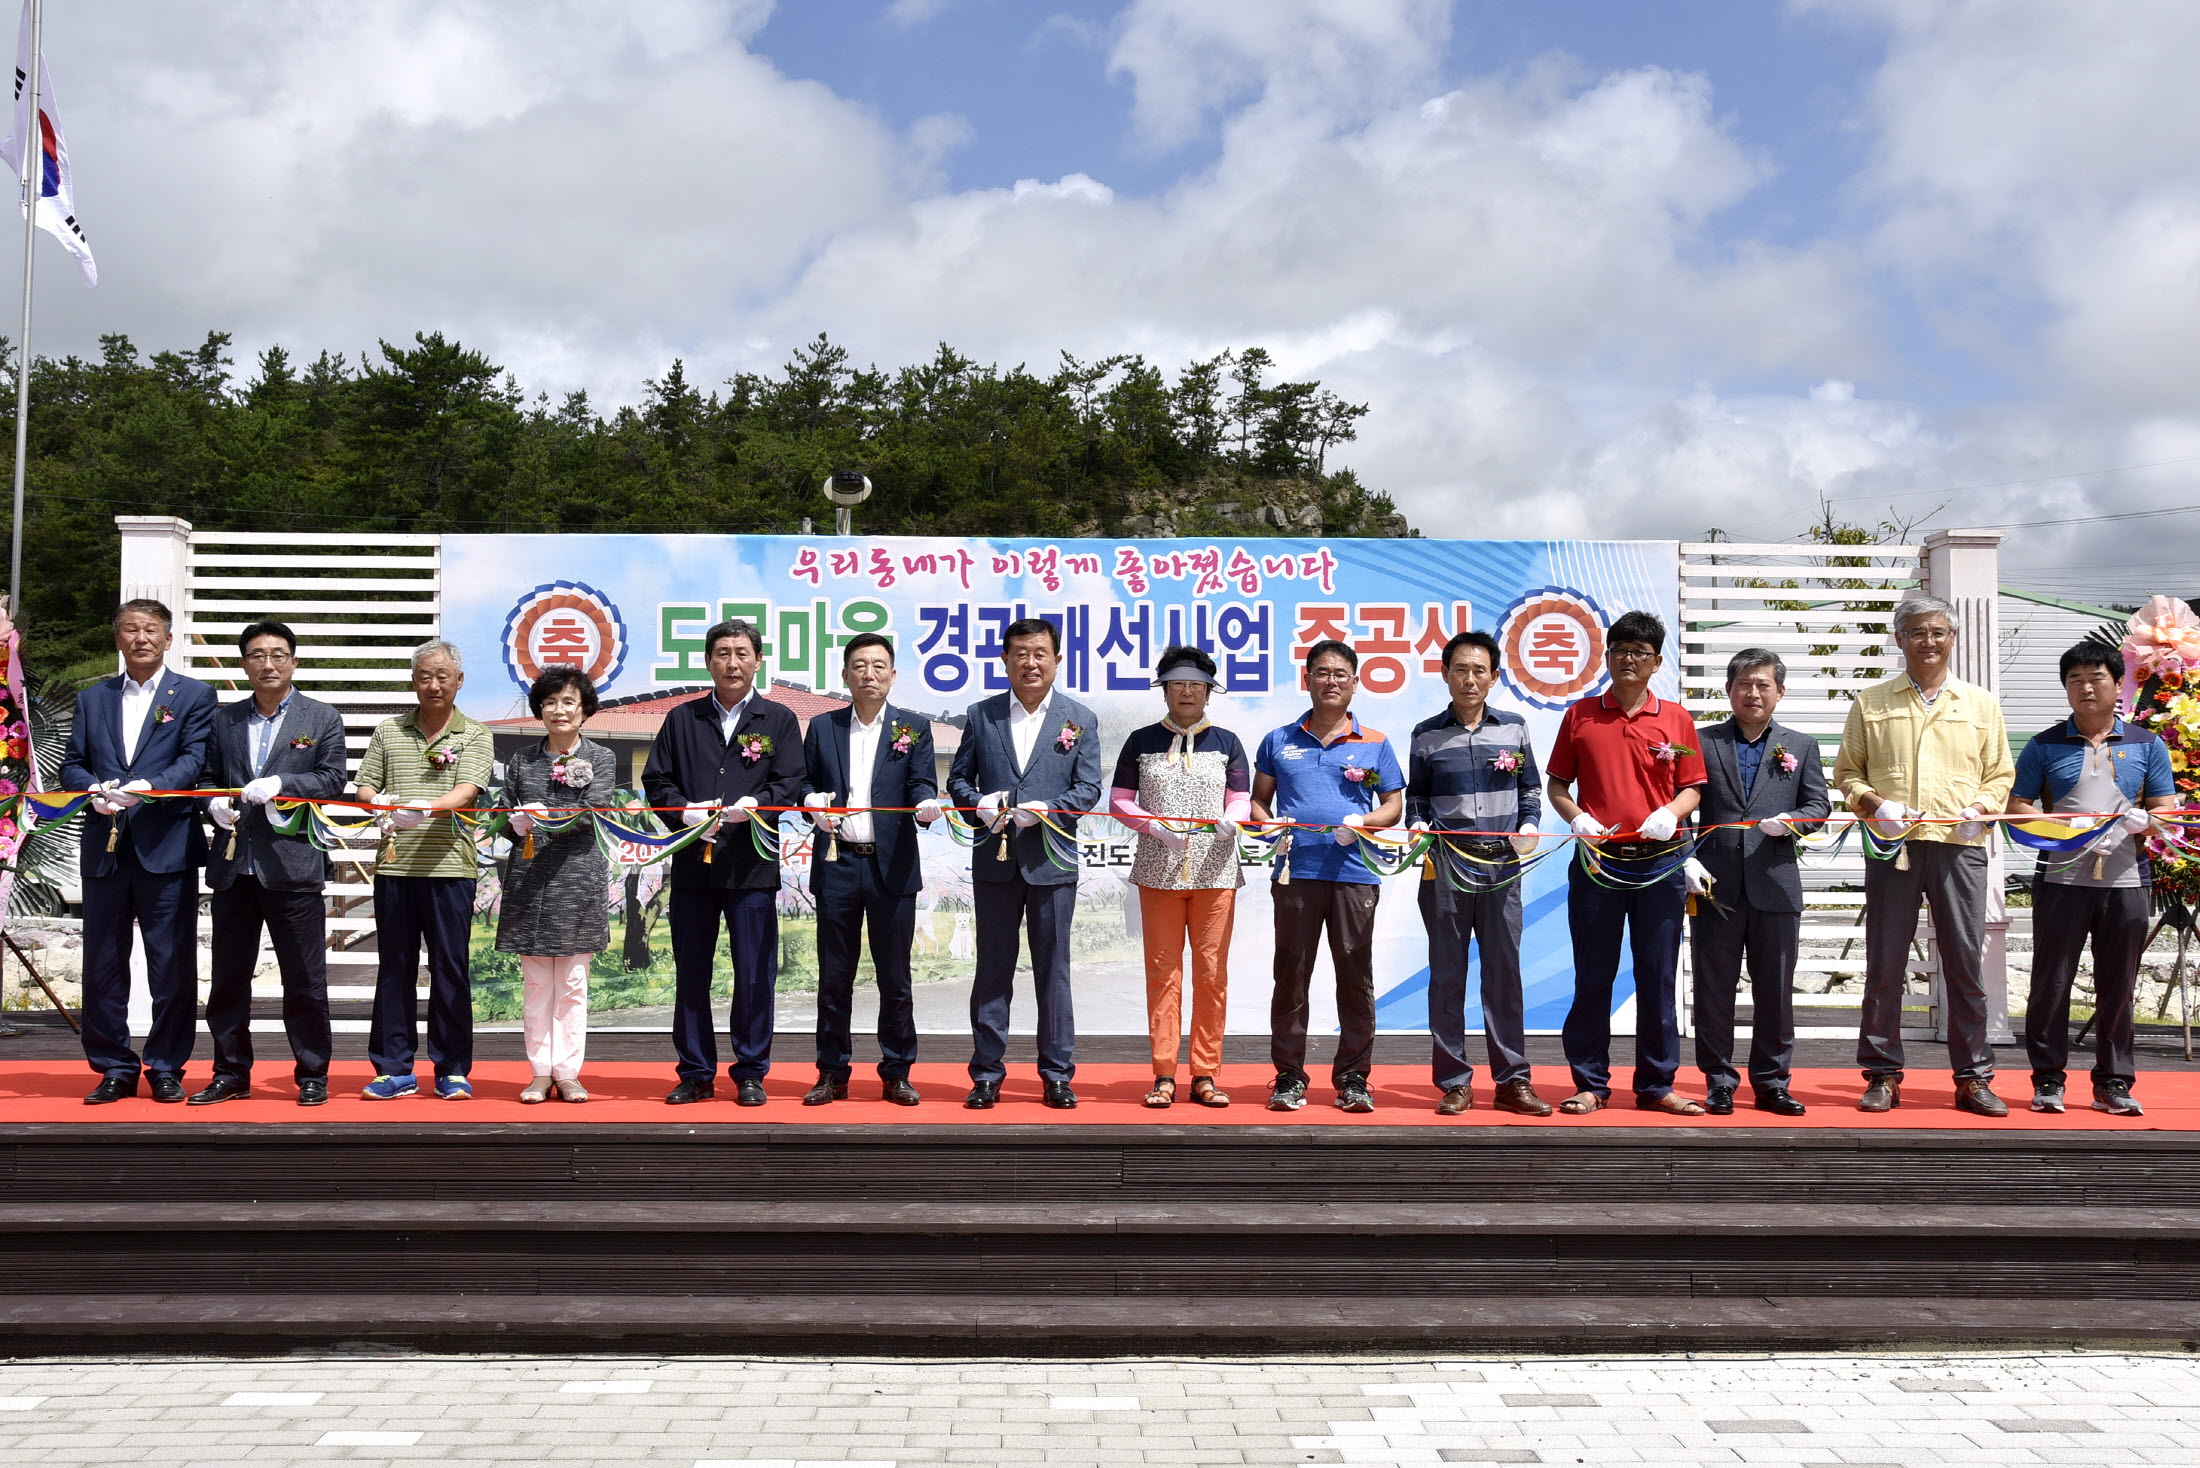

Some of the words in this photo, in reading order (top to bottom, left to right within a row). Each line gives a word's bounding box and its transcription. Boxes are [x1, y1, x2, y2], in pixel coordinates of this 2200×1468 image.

[992, 549, 1098, 591] 이렇게
[1116, 550, 1335, 593] 좋아졌습니다
[538, 618, 590, 670] 축
[1528, 624, 1579, 675] 축
[1082, 843, 1138, 867] 진도
